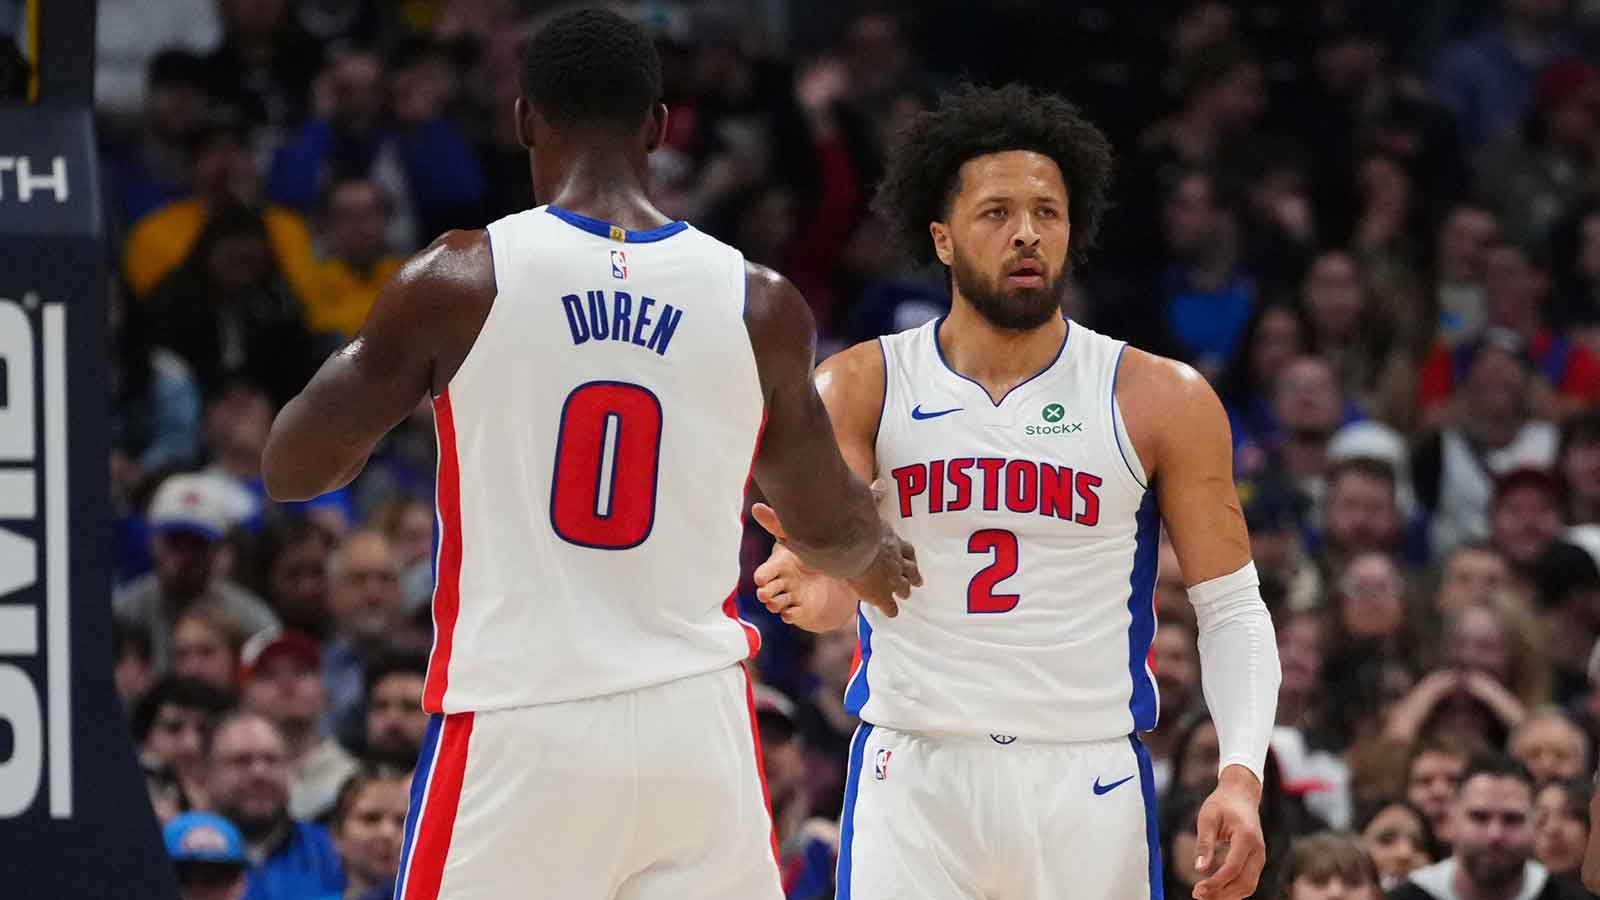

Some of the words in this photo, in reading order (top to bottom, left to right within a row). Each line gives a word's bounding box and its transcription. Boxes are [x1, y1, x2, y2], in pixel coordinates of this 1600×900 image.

[561, 290, 683, 356] DUREN
[1025, 422, 1083, 436] StockX
[549, 380, 663, 551] 0
[891, 457, 1103, 528] PISTONS
[966, 528, 1021, 614] 2
